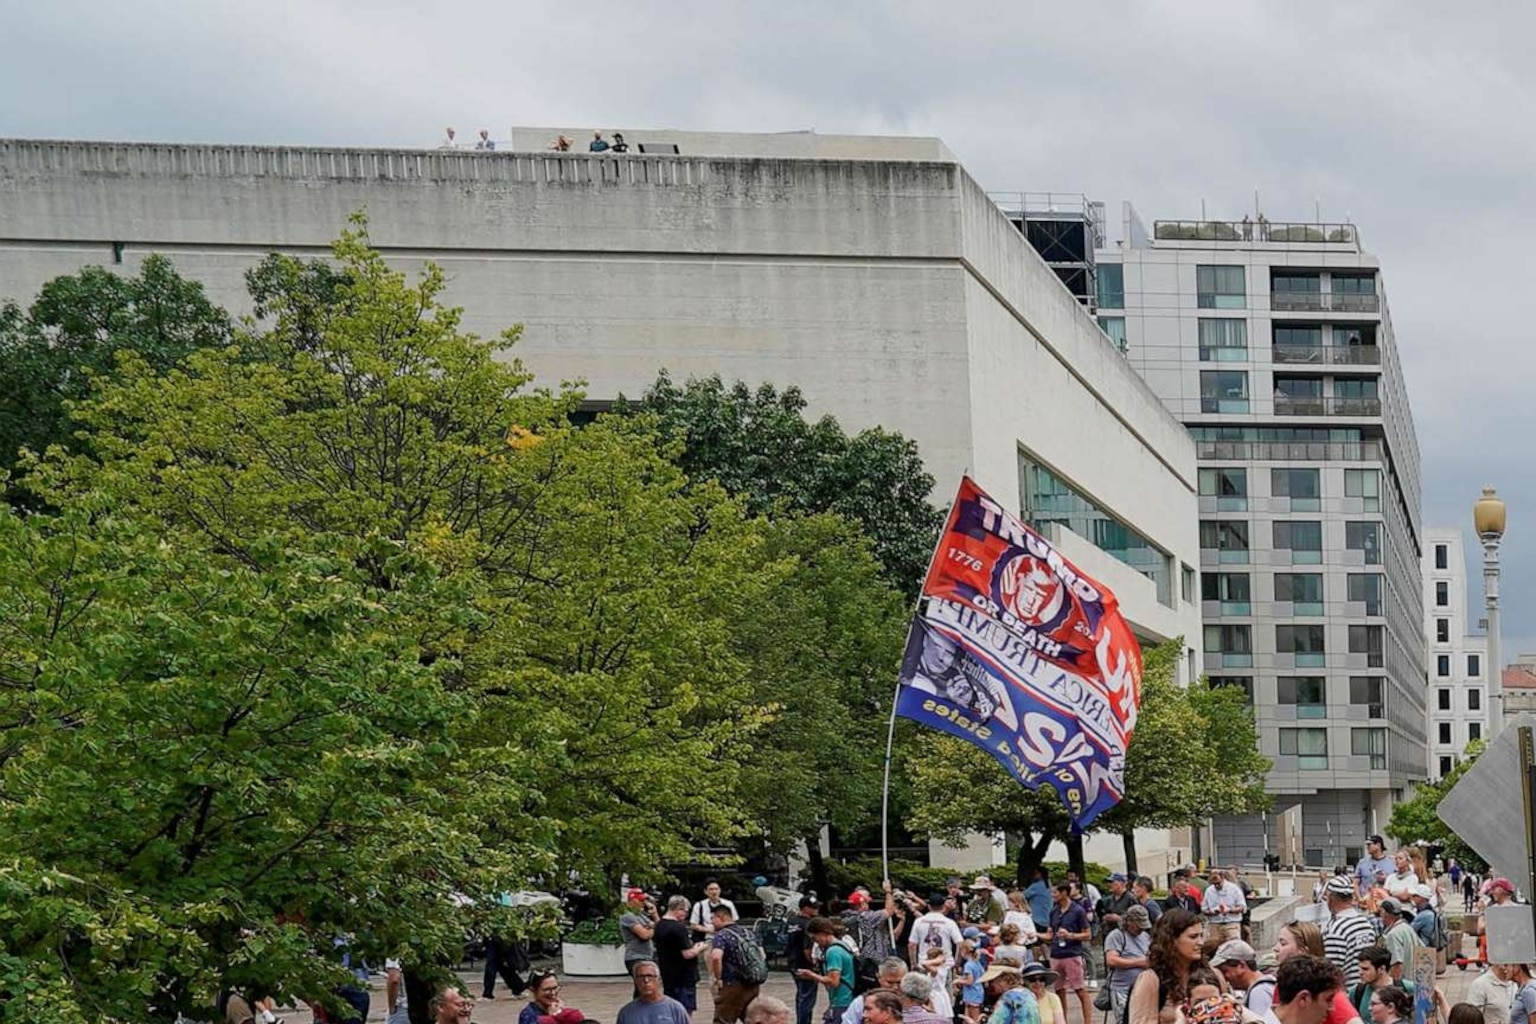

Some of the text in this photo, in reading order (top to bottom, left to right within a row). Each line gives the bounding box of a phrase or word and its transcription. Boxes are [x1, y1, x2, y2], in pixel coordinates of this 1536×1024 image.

[949, 547, 983, 572] 1776
[979, 496, 1100, 602] TRUMP
[972, 595, 1062, 658] OR DEATH
